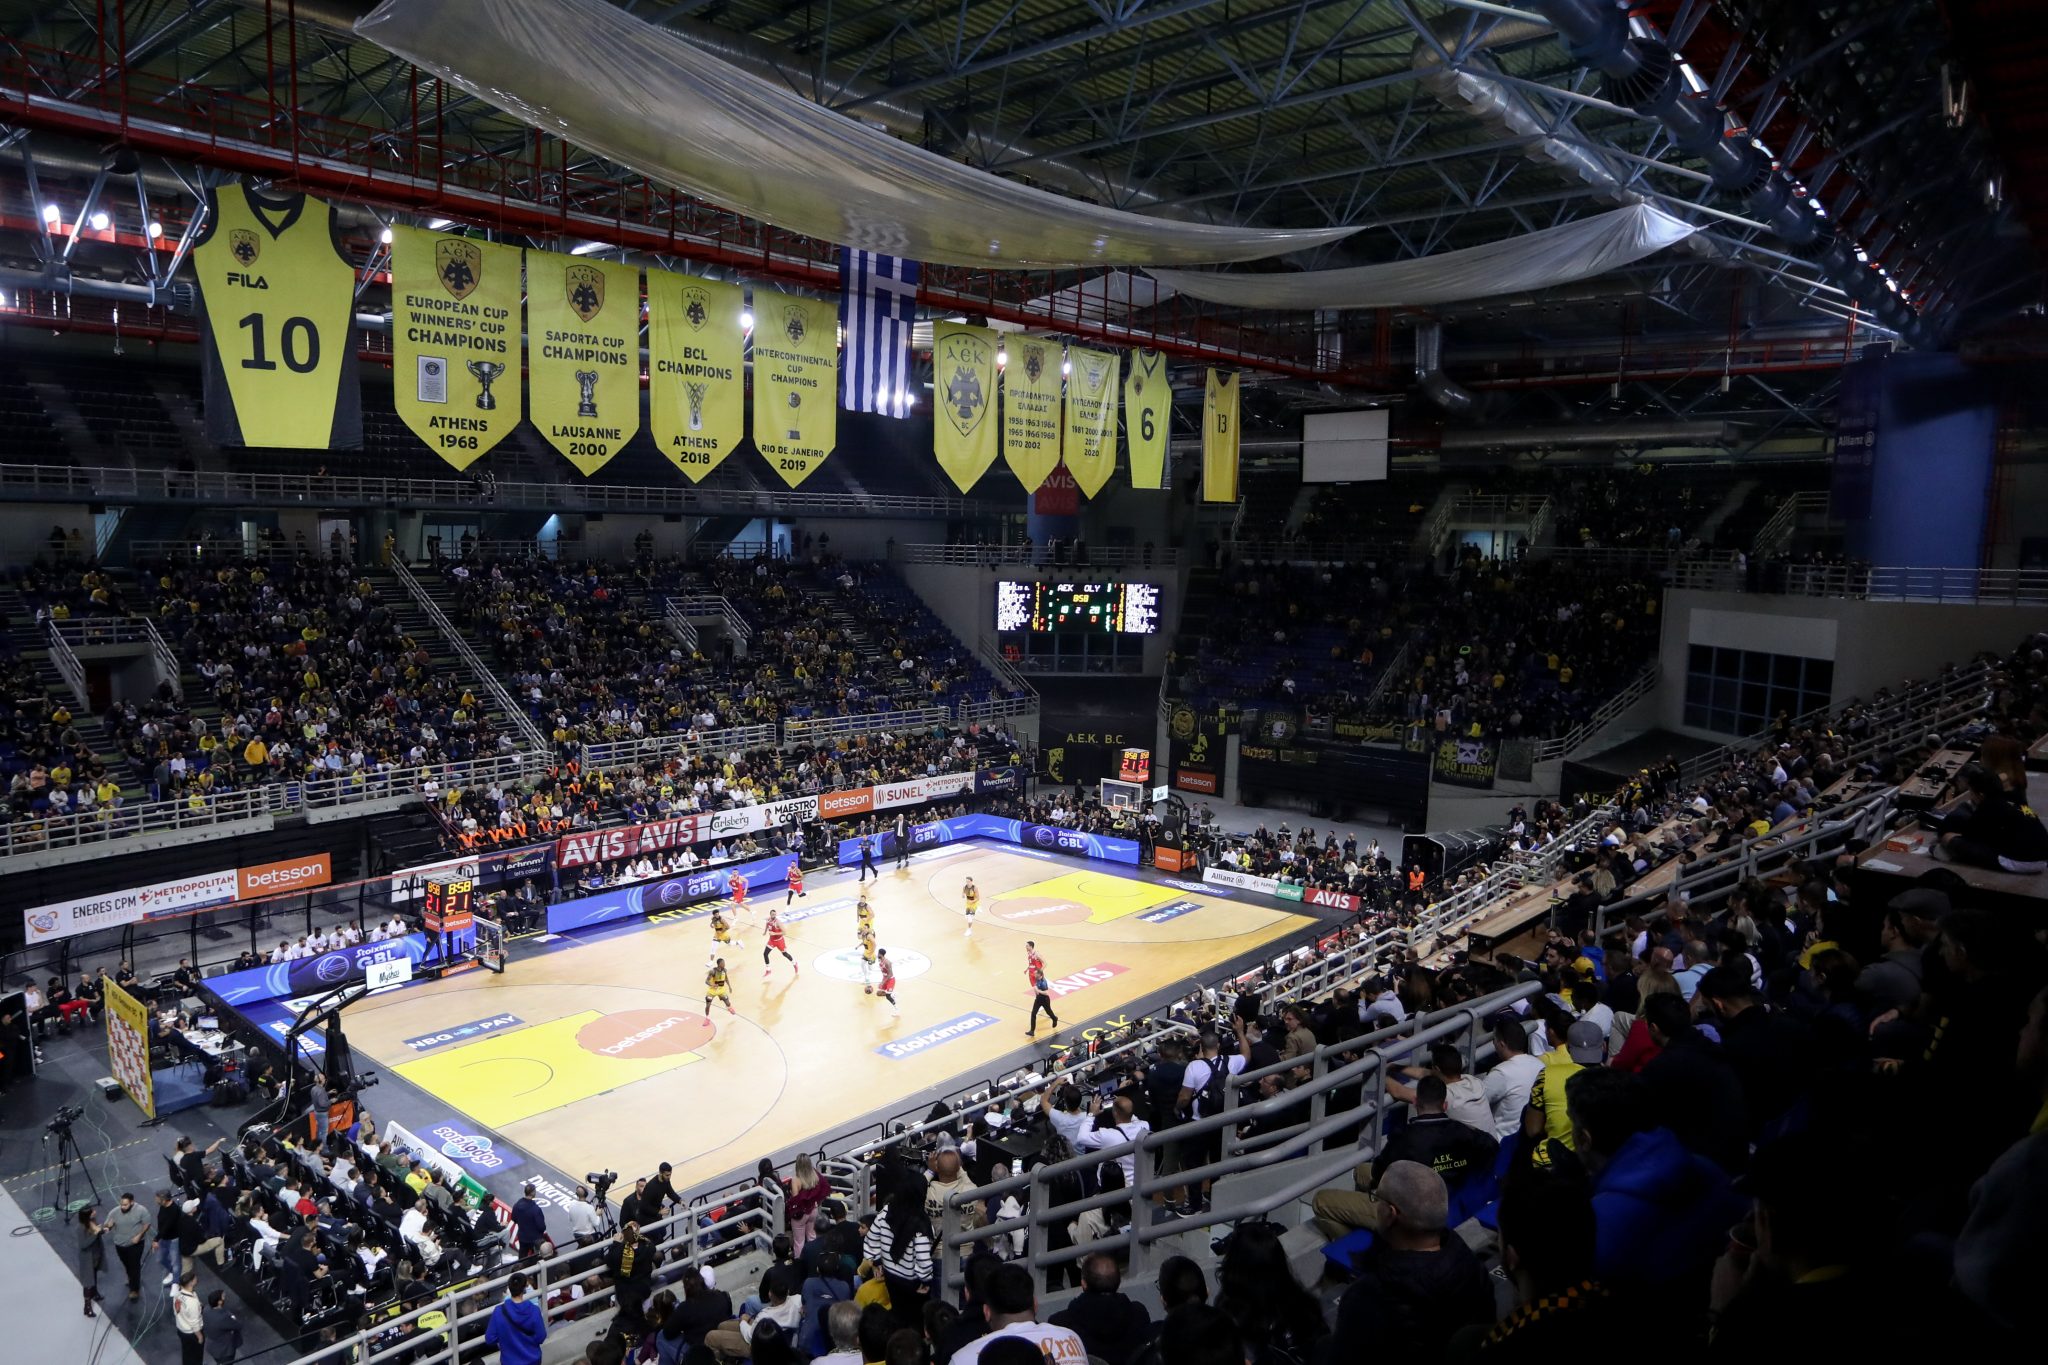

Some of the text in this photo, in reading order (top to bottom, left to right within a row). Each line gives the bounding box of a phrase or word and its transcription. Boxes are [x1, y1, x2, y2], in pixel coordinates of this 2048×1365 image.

[227, 272, 270, 290] FILA
[406, 295, 509, 320] EUROPEAN CUP
[480, 321, 506, 335] CUP
[239, 312, 321, 374] 10
[407, 327, 507, 354] CHAMPIONS
[545, 331, 625, 348] SAPORTA CUP
[542, 345, 628, 366] CHAMPIONS
[683, 346, 708, 361] BCL
[755, 347, 833, 368] INTERCONTINENTAL
[657, 360, 733, 380] CHAMPIONS
[787, 364, 803, 374] CUP
[771, 374, 818, 388] CHAMPIONS
[1018, 402, 1048, 413] ΕΛΛΑΔΑΣ
[429, 415, 489, 432] ATHENS
[1008, 417, 1056, 428] 1958 1963 1964
[1141, 407, 1154, 441] 6
[1218, 414, 1227, 434] 13
[552, 425, 622, 441] LAUSANNE
[1008, 428, 1024, 437] 1965
[1025, 430, 1040, 438] 1966
[438, 433, 479, 450] 1968
[569, 442, 607, 457] 2000
[673, 435, 718, 449] ATHENS
[1008, 440, 1040, 450] 1970 2002
[1837, 436, 1864, 447] Allianz
[680, 451, 710, 465] 2018
[761, 444, 824, 458] RIO DE JANEIRO
[1084, 449, 1099, 457] 2020
[780, 458, 806, 471] 2019
[1043, 475, 1075, 489] AVIS
[1057, 584, 1101, 592] AEK OLY
[1067, 733, 1126, 745] A.E.K. B.C.
[1122, 759, 1136, 770] 21
[1138, 759, 1148, 770] 21
[933, 776, 973, 787] METROPOLITAN
[1180, 775, 1212, 787] betsson
[887, 785, 924, 801] SUNEL
[774, 799, 817, 815] MAESTRO
[824, 794, 869, 810] betsson
[710, 813, 750, 833] Carlsberg
[562, 817, 694, 866] AVIS AVIS
[915, 829, 936, 844] GBL
[1058, 837, 1083, 849] GBL
[247, 862, 323, 888] betsson
[1211, 872, 1235, 883] Allianz
[154, 874, 235, 898] METROPOLITAN
[448, 880, 472, 895] 8:58
[688, 880, 716, 897] GBL
[154, 885, 235, 905] GENERAL
[426, 893, 439, 912] 21
[1312, 890, 1351, 909] AVIS
[72, 901, 113, 919] ENERES
[114, 896, 136, 910] CPM
[445, 894, 468, 913] 21
[445, 917, 471, 928] betsson
[357, 950, 397, 970] GBL
[1050, 966, 1115, 996] AVIS
[407, 1015, 516, 1049] NBG PAY
[599, 1016, 682, 1055] betsson
[885, 1016, 986, 1058] Stoiximan
[1433, 1153, 1453, 1165] A.E.K.
[1453, 1159, 1468, 1168] CLUB
